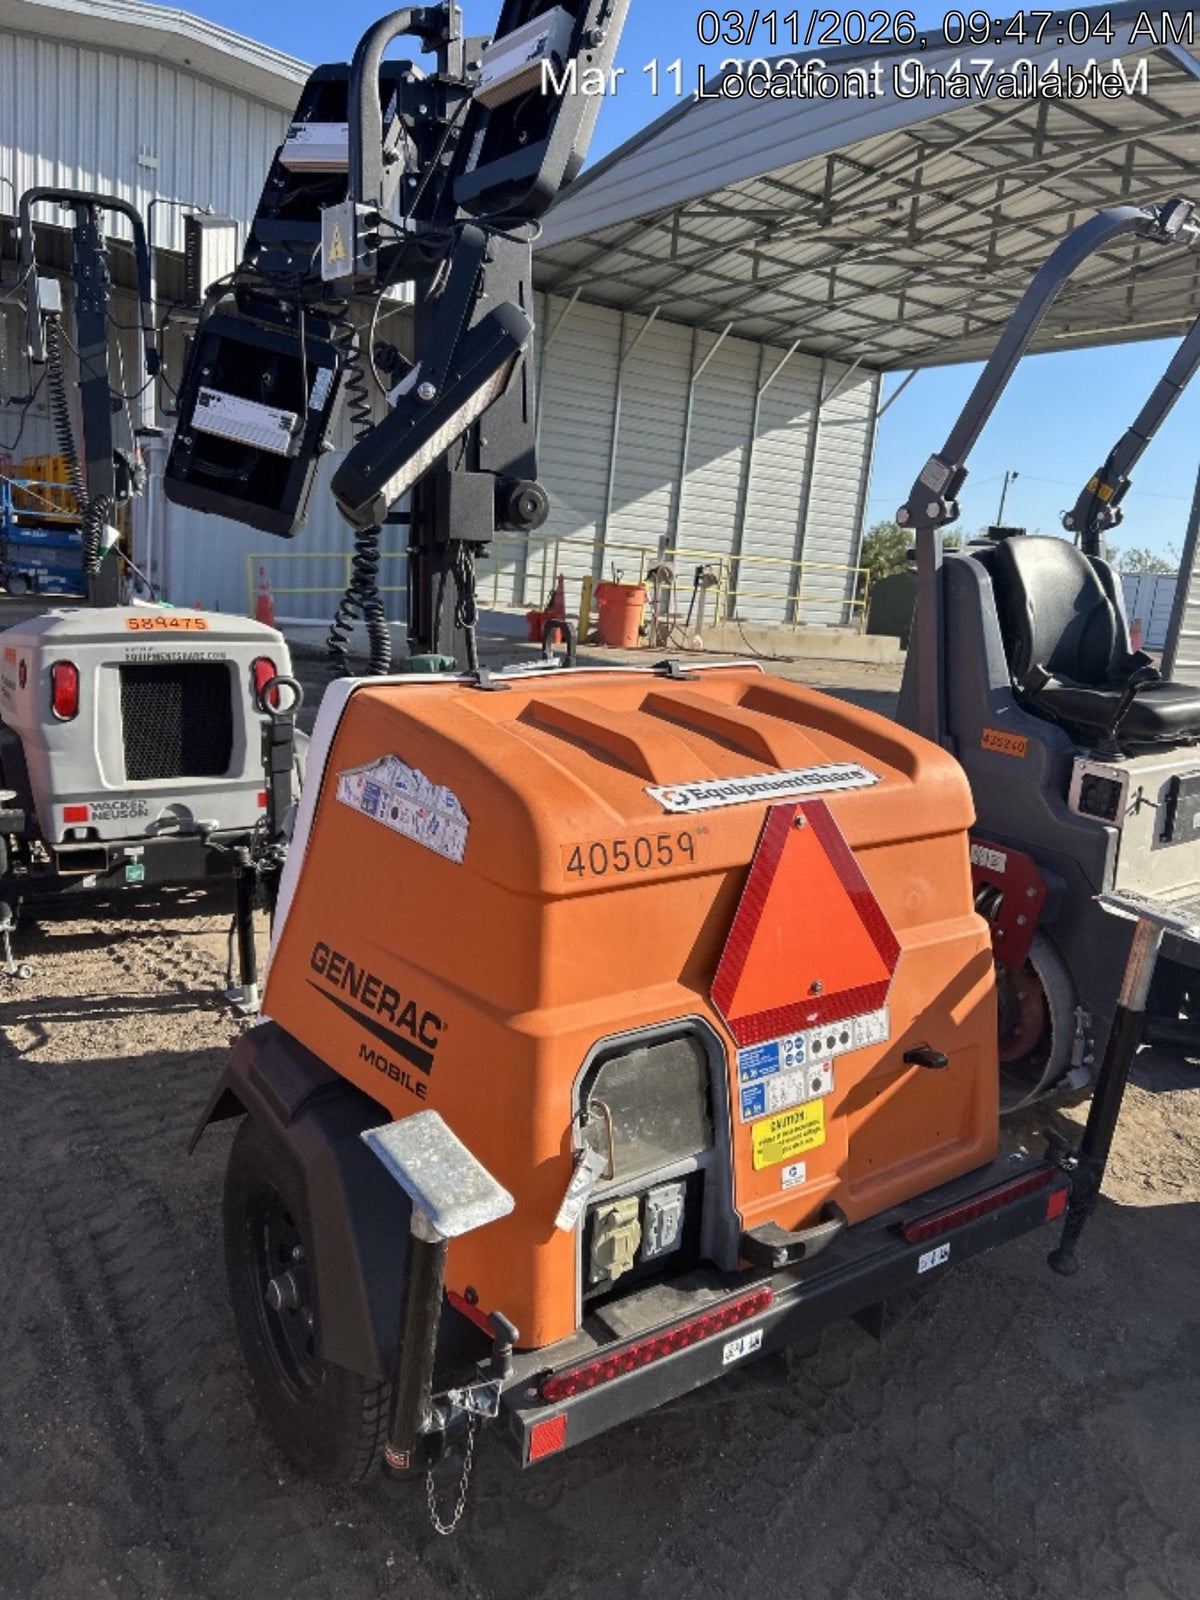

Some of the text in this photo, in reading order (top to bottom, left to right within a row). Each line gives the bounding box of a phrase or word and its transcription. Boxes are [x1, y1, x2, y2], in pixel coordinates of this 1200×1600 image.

[128, 616, 208, 630] 589475
[690, 770, 866, 801] EquipmentShare
[89, 799, 148, 811] WACKER
[92, 809, 149, 821] NEUSON
[566, 831, 695, 877] 405059
[310, 941, 442, 1050] GENERAC
[358, 1043, 428, 1101] MOBILE
